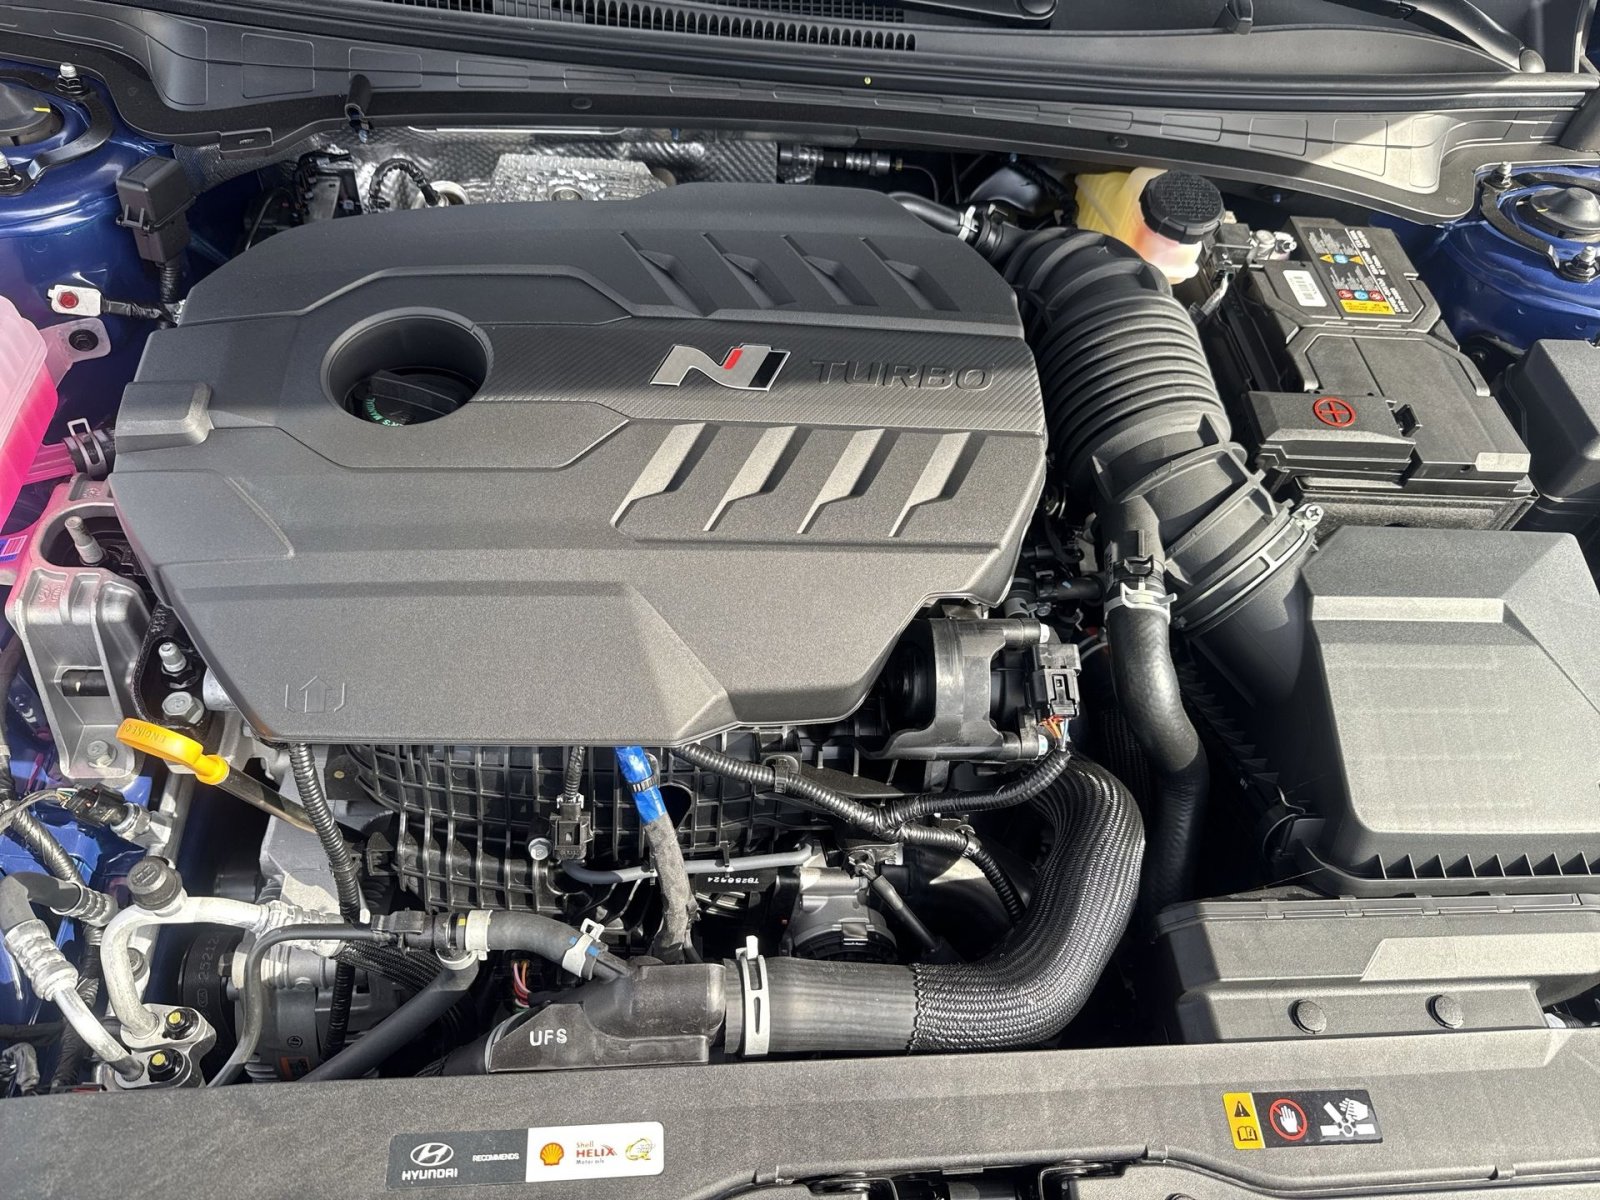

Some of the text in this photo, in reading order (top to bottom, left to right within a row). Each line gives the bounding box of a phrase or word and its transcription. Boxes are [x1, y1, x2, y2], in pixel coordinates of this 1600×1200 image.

[811, 359, 996, 392] TURBO
[529, 1028, 568, 1047] UFS
[576, 1140, 594, 1149] Shell
[472, 1152, 521, 1163] RECOMMENDS
[576, 1145, 618, 1158] HELIX
[401, 1167, 459, 1181] HYUNDAI
